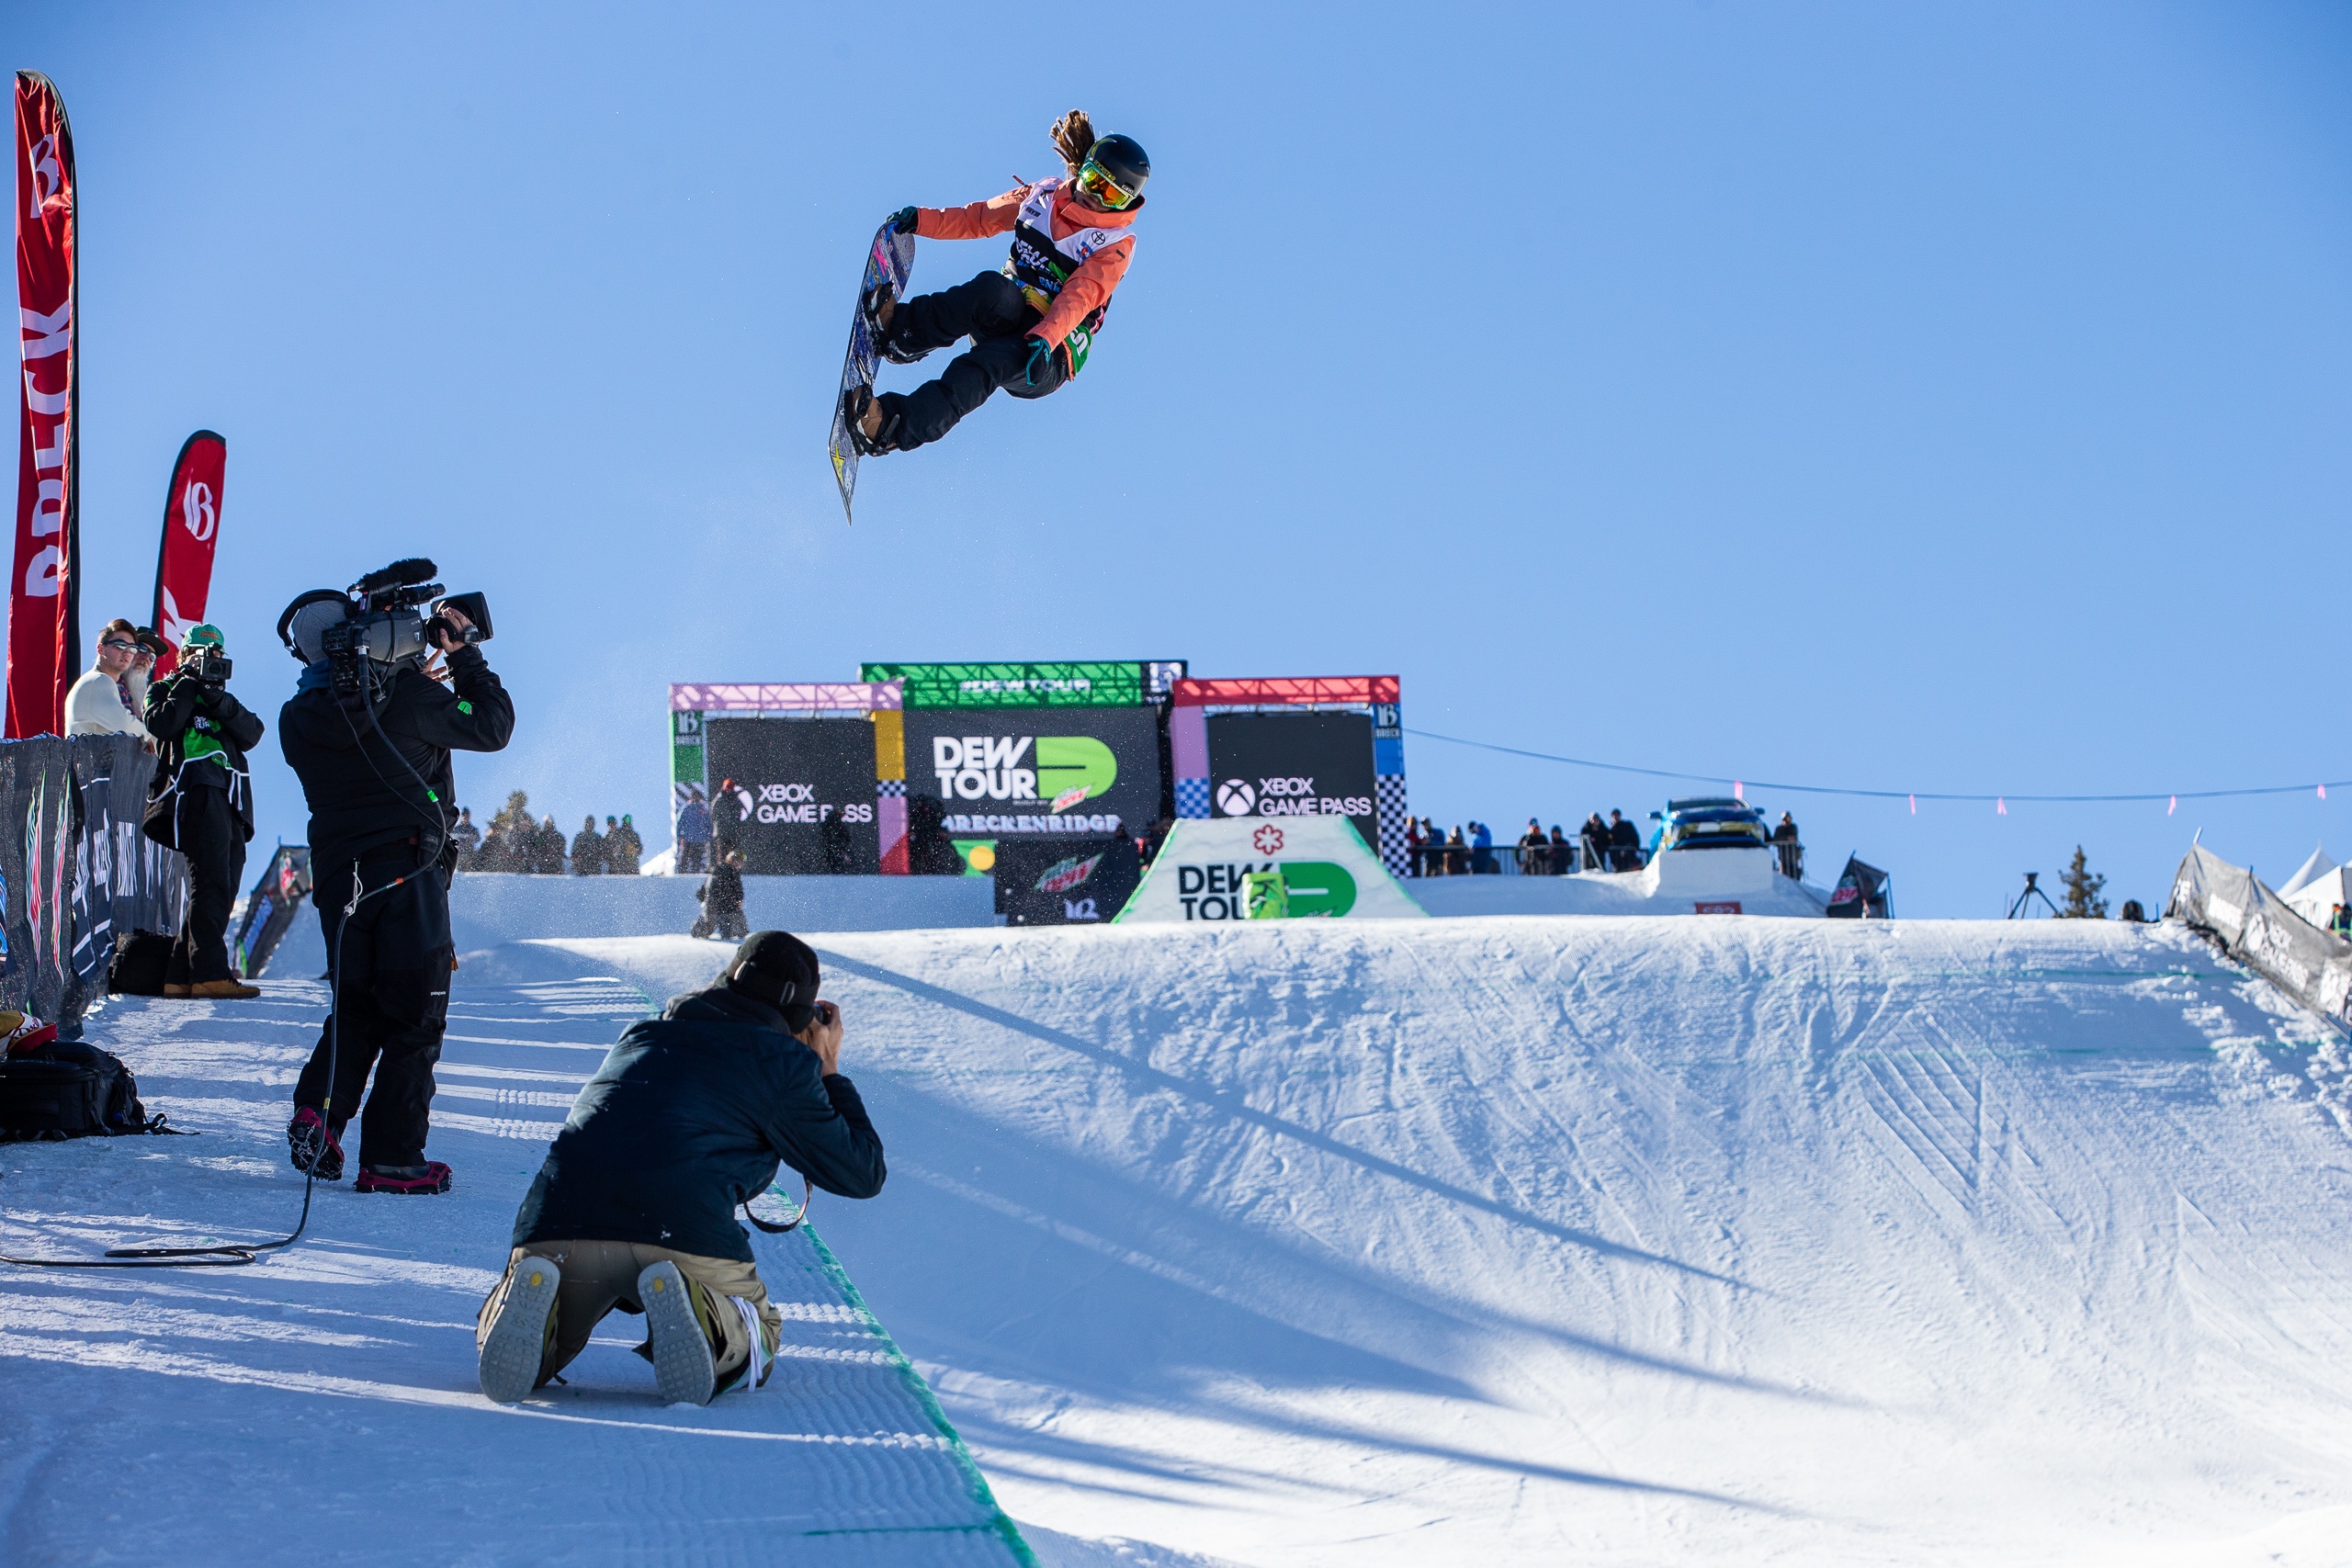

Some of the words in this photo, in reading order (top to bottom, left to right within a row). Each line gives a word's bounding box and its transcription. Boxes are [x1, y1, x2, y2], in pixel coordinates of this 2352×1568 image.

[933, 736, 1034, 769] DEW
[758, 784, 815, 803] XBOX
[934, 769, 1038, 800] TOUR
[1259, 777, 1316, 796] XBOX
[756, 804, 818, 824] GAME
[820, 804, 873, 823] PSS
[1259, 798, 1318, 817] GAME
[1319, 797, 1373, 816] PASS
